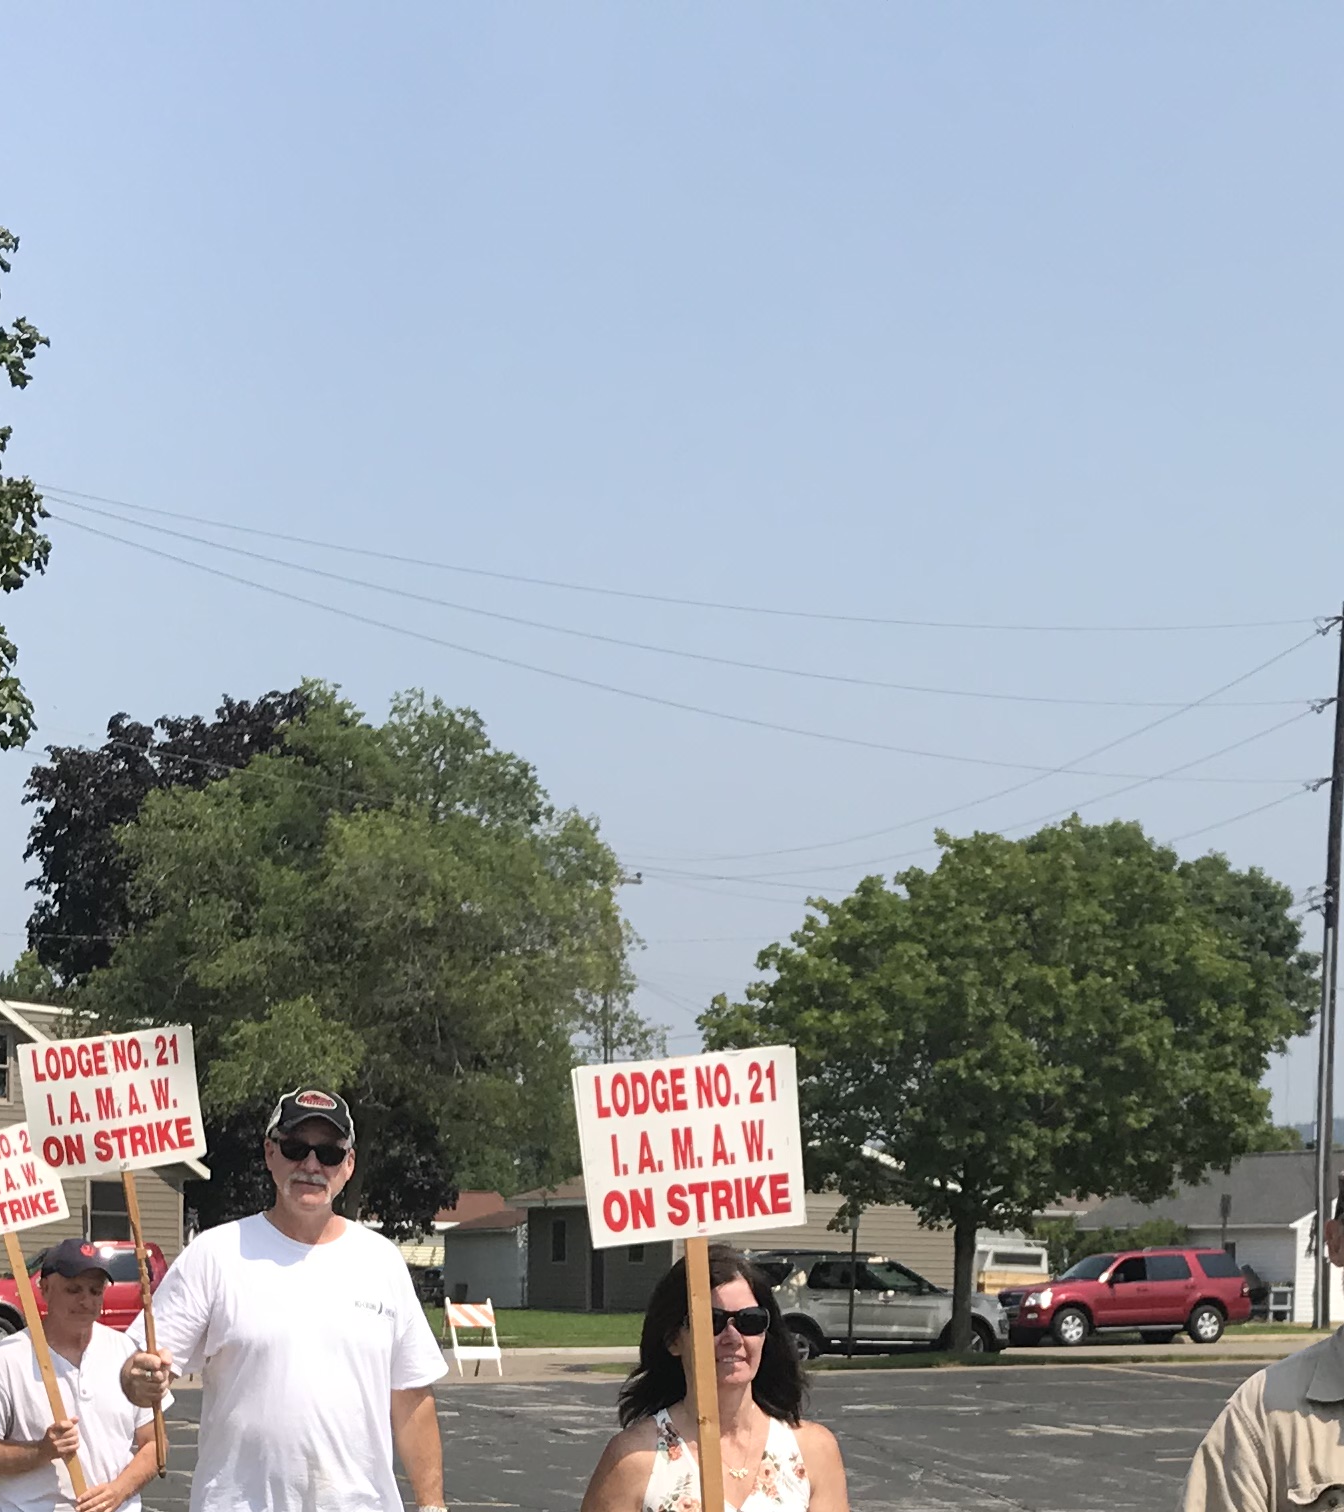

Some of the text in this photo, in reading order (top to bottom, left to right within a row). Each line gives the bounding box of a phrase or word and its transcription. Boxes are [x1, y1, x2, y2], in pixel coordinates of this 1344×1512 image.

[31, 1034, 178, 1083] LODGE NO. 21
[594, 1060, 777, 1119] LODGE NO. 21
[19, 1130, 32, 1153] 2
[42, 1116, 195, 1168] ON STRIKE
[603, 1173, 792, 1233] ON STRIKE
